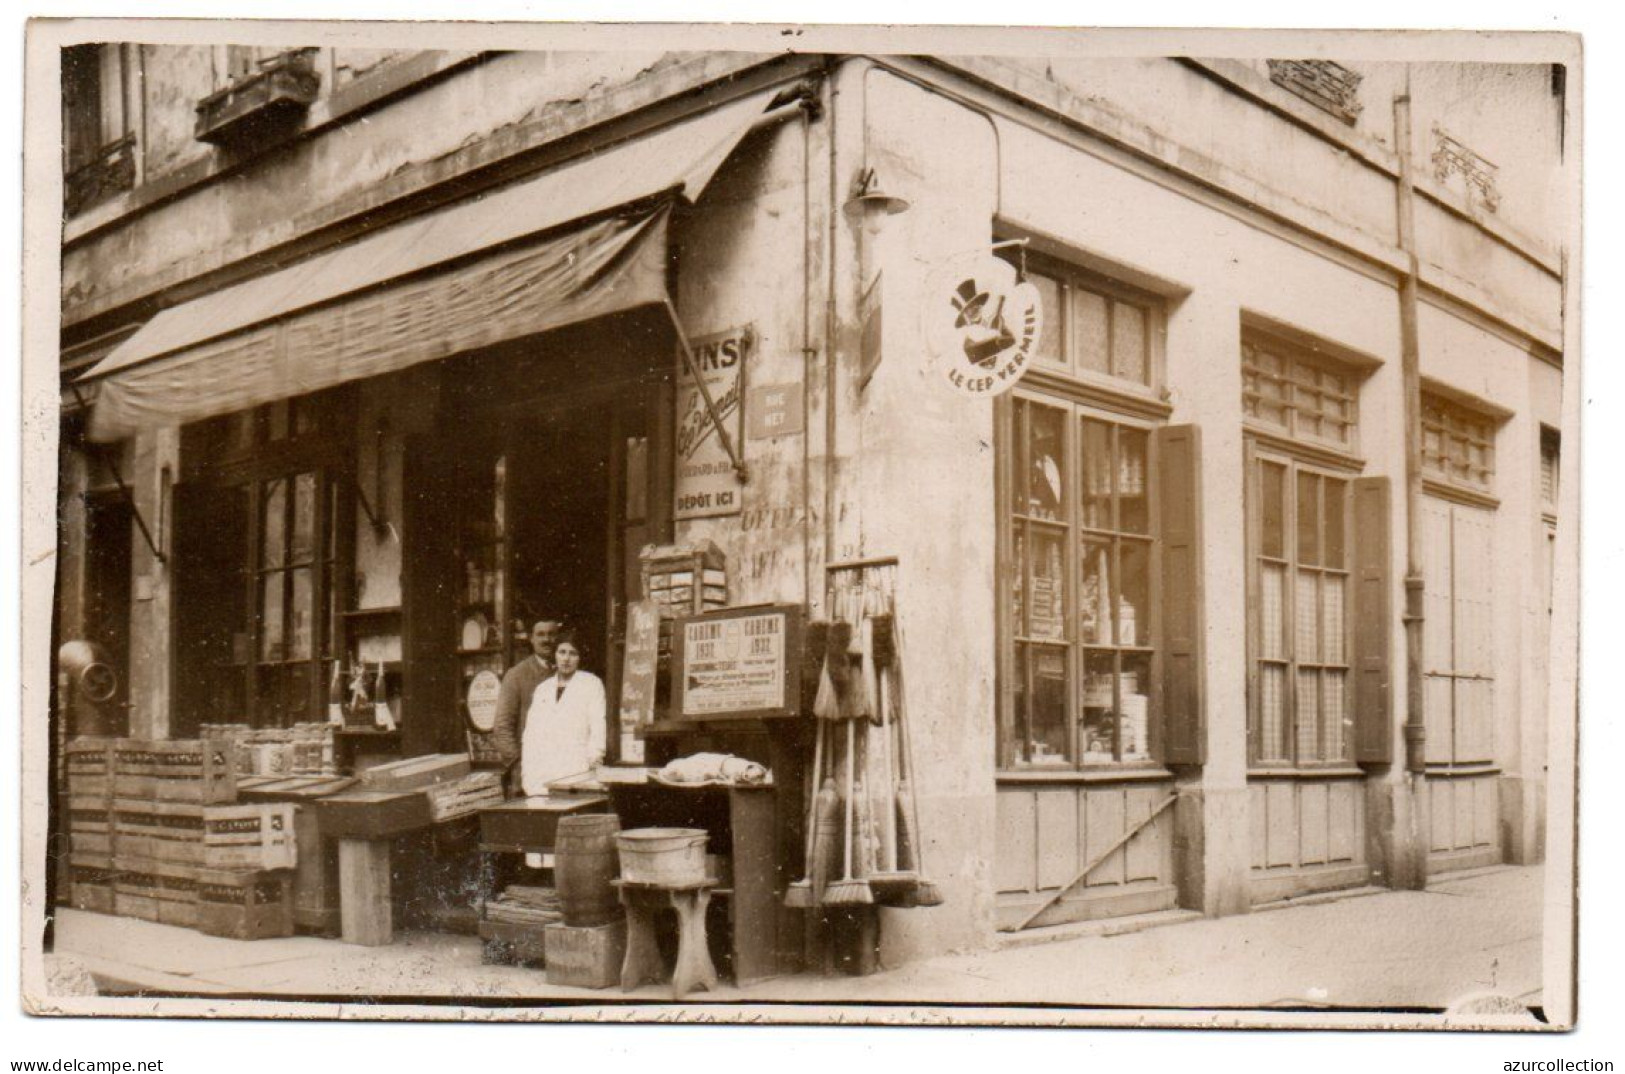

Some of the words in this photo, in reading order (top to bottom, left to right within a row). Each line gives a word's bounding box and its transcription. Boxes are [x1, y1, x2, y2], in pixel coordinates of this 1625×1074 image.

[948, 367, 965, 388] LE
[967, 377, 994, 392] CEP
[997, 303, 1036, 381] VERMEIL
[716, 491, 733, 506] ICI
